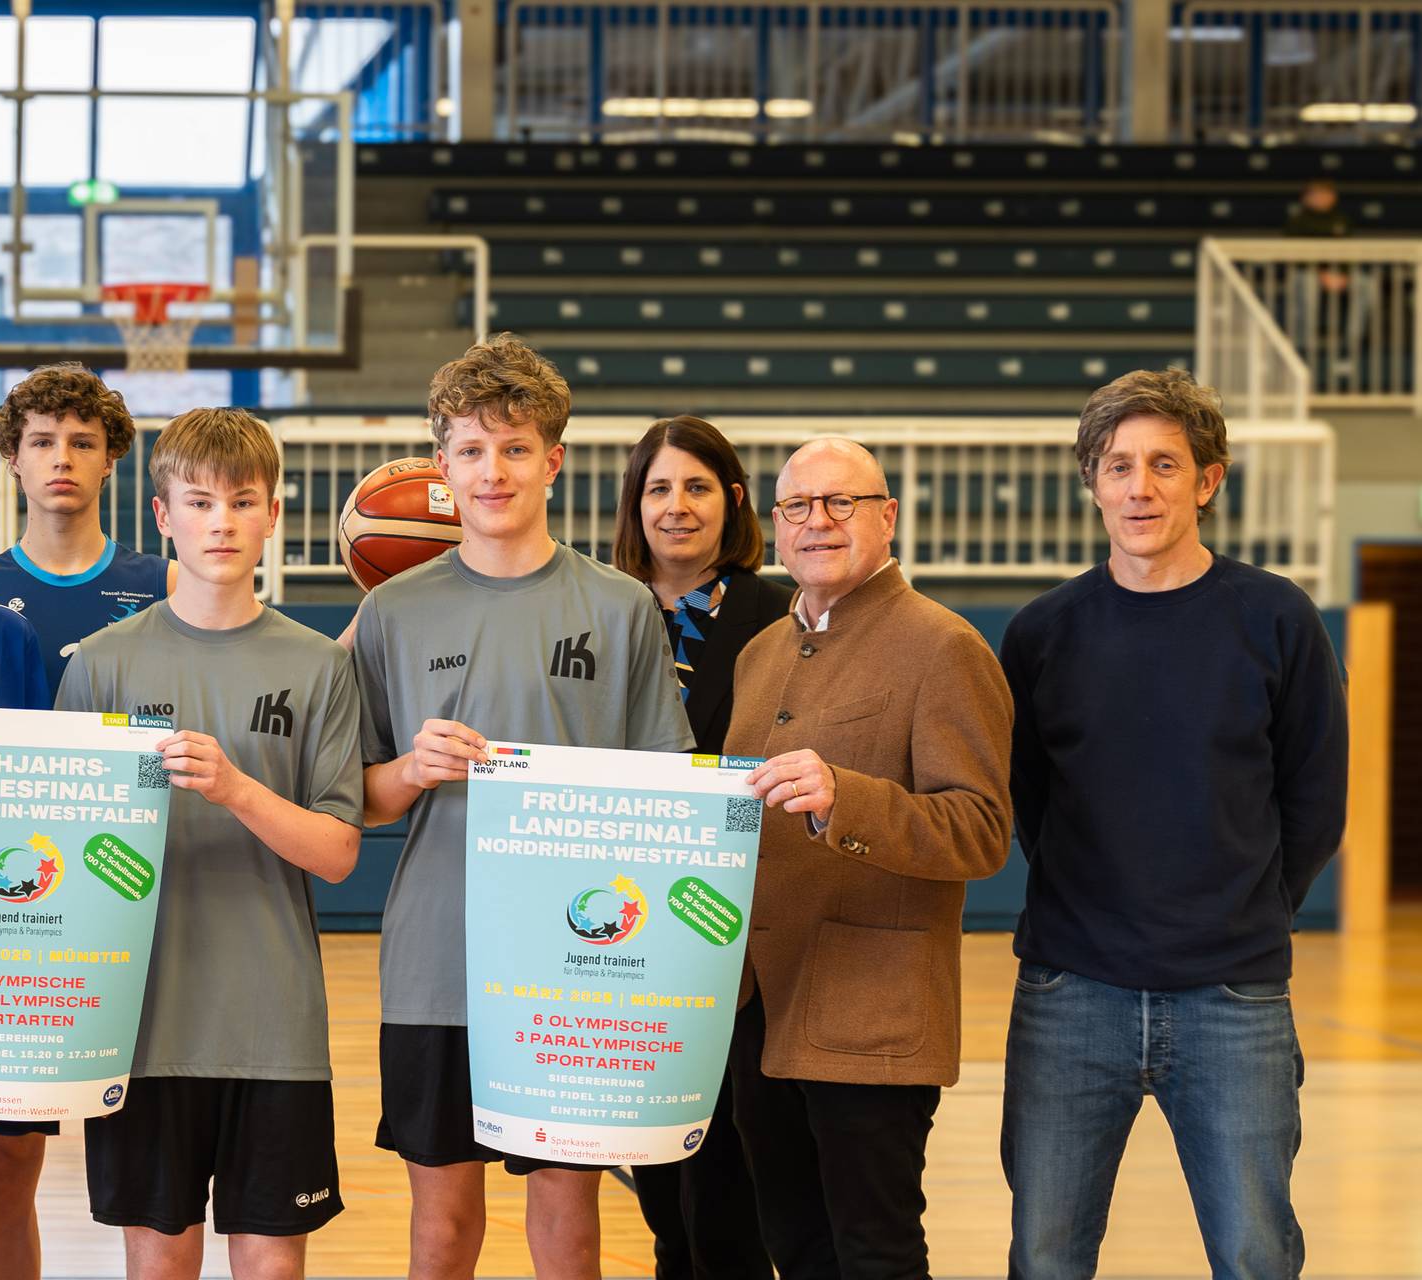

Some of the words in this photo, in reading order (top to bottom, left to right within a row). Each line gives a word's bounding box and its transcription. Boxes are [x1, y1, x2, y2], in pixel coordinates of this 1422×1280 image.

[428, 654, 467, 672] JAKO
[105, 717, 127, 725] STADT
[139, 718, 172, 728] MÜNSTER
[474, 759, 530, 769] SORTLAND.
[474, 766, 495, 774] NRW
[694, 758, 717, 767] STADT
[522, 789, 698, 819] FRÜHJAHRS-
[510, 815, 718, 846] LANDESFINALE
[102, 838, 113, 848] 10
[111, 845, 151, 879] Sportstätten
[477, 836, 747, 868] NORDRHEIN-WESTFALEN
[96, 848, 108, 858] 90
[107, 856, 143, 887] Schulteams
[84, 853, 99, 866] 700
[98, 863, 142, 900] Teilnehmende
[687, 881, 698, 892] 10
[697, 888, 738, 924] Sportstätten
[22, 913, 62, 924] trainiert
[682, 891, 693, 902] 90
[692, 900, 730, 932] Schulteams
[668, 896, 684, 909] 700
[683, 907, 729, 945] Teilnehmende
[19, 927, 24, 935] &
[26, 927, 62, 937] Paralympics
[49, 948, 131, 964] MÜNSTER
[565, 952, 601, 966] Jugend
[604, 955, 645, 968] trainiert
[574, 967, 598, 978] Olympia
[600, 969, 605, 977] &
[607, 969, 645, 980] Paralympics
[514, 984, 563, 1000] MÄRZ
[630, 992, 716, 1008] MÜNSTER
[533, 1014, 543, 1025] 6
[549, 1015, 668, 1033] OLYMPISCHE
[515, 1031, 525, 1043] 3
[530, 1033, 684, 1053] PARALYMPISCHE
[68, 1050, 96, 1059] 17.30
[99, 1048, 118, 1057] UHR
[536, 1053, 656, 1071] SPORTARTEN
[32, 1066, 58, 1075] FREI
[548, 1074, 645, 1088] SIEGEREHRUNG
[489, 1080, 522, 1094] HALLE
[524, 1087, 556, 1098] BERG
[560, 1091, 595, 1101] FIDEL
[648, 1095, 678, 1104] 17.30
[681, 1093, 702, 1103] UHR
[551, 1106, 608, 1119] EINTRITT
[612, 1110, 639, 1119] FREI
[477, 1119, 503, 1134] molten
[551, 1136, 601, 1148] Sparkassen
[551, 1148, 558, 1156] in
[561, 1148, 649, 1161] Nordrhein-Westfalen
[311, 1188, 329, 1203] JAKO
